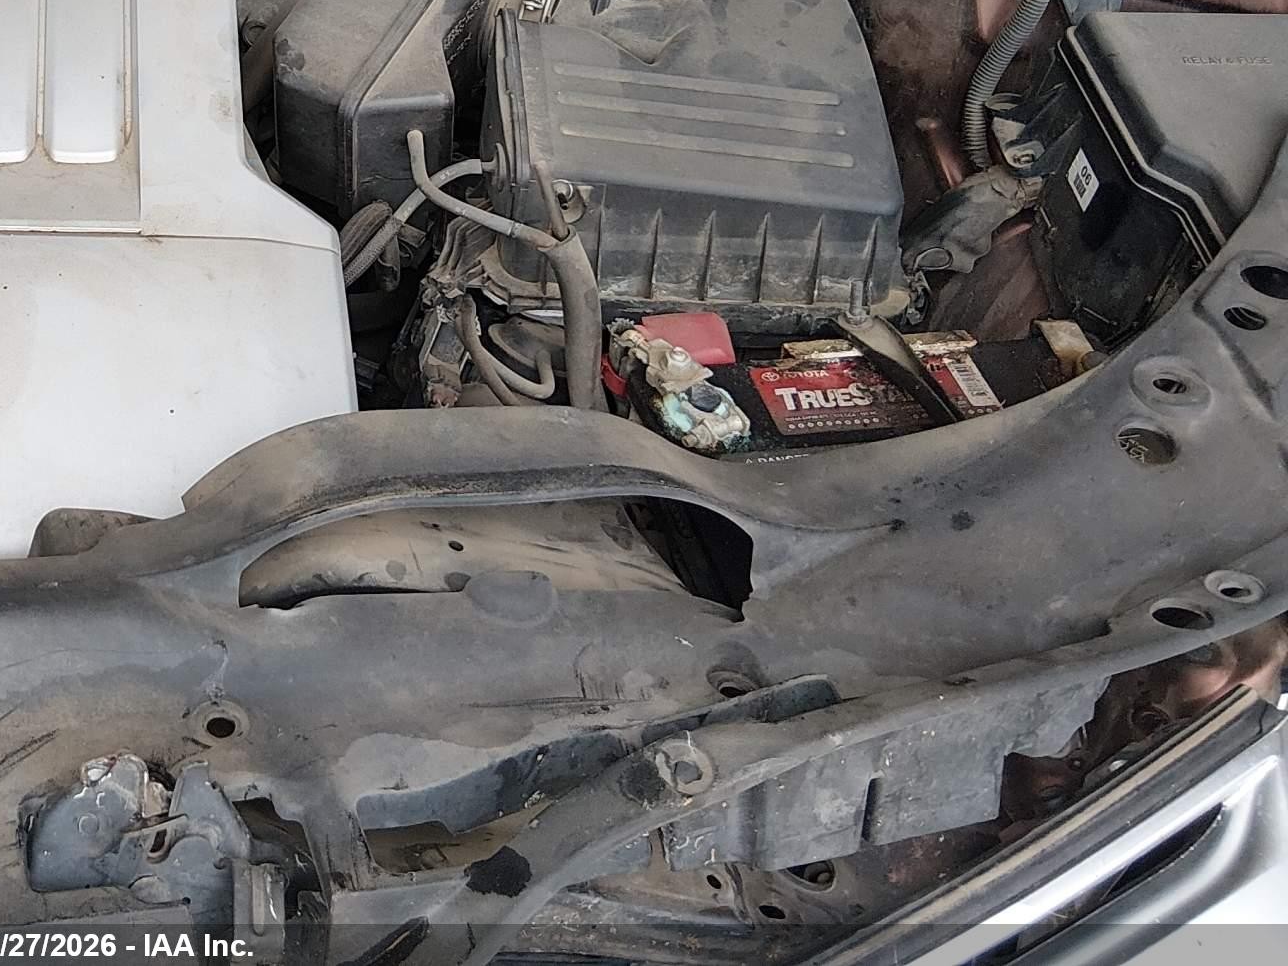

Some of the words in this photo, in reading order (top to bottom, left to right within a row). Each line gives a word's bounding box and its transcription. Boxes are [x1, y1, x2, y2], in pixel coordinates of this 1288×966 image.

[1182, 57, 1222, 66] RELAY
[1237, 57, 1273, 66] FUSE
[783, 370, 829, 379] TOYOTA
